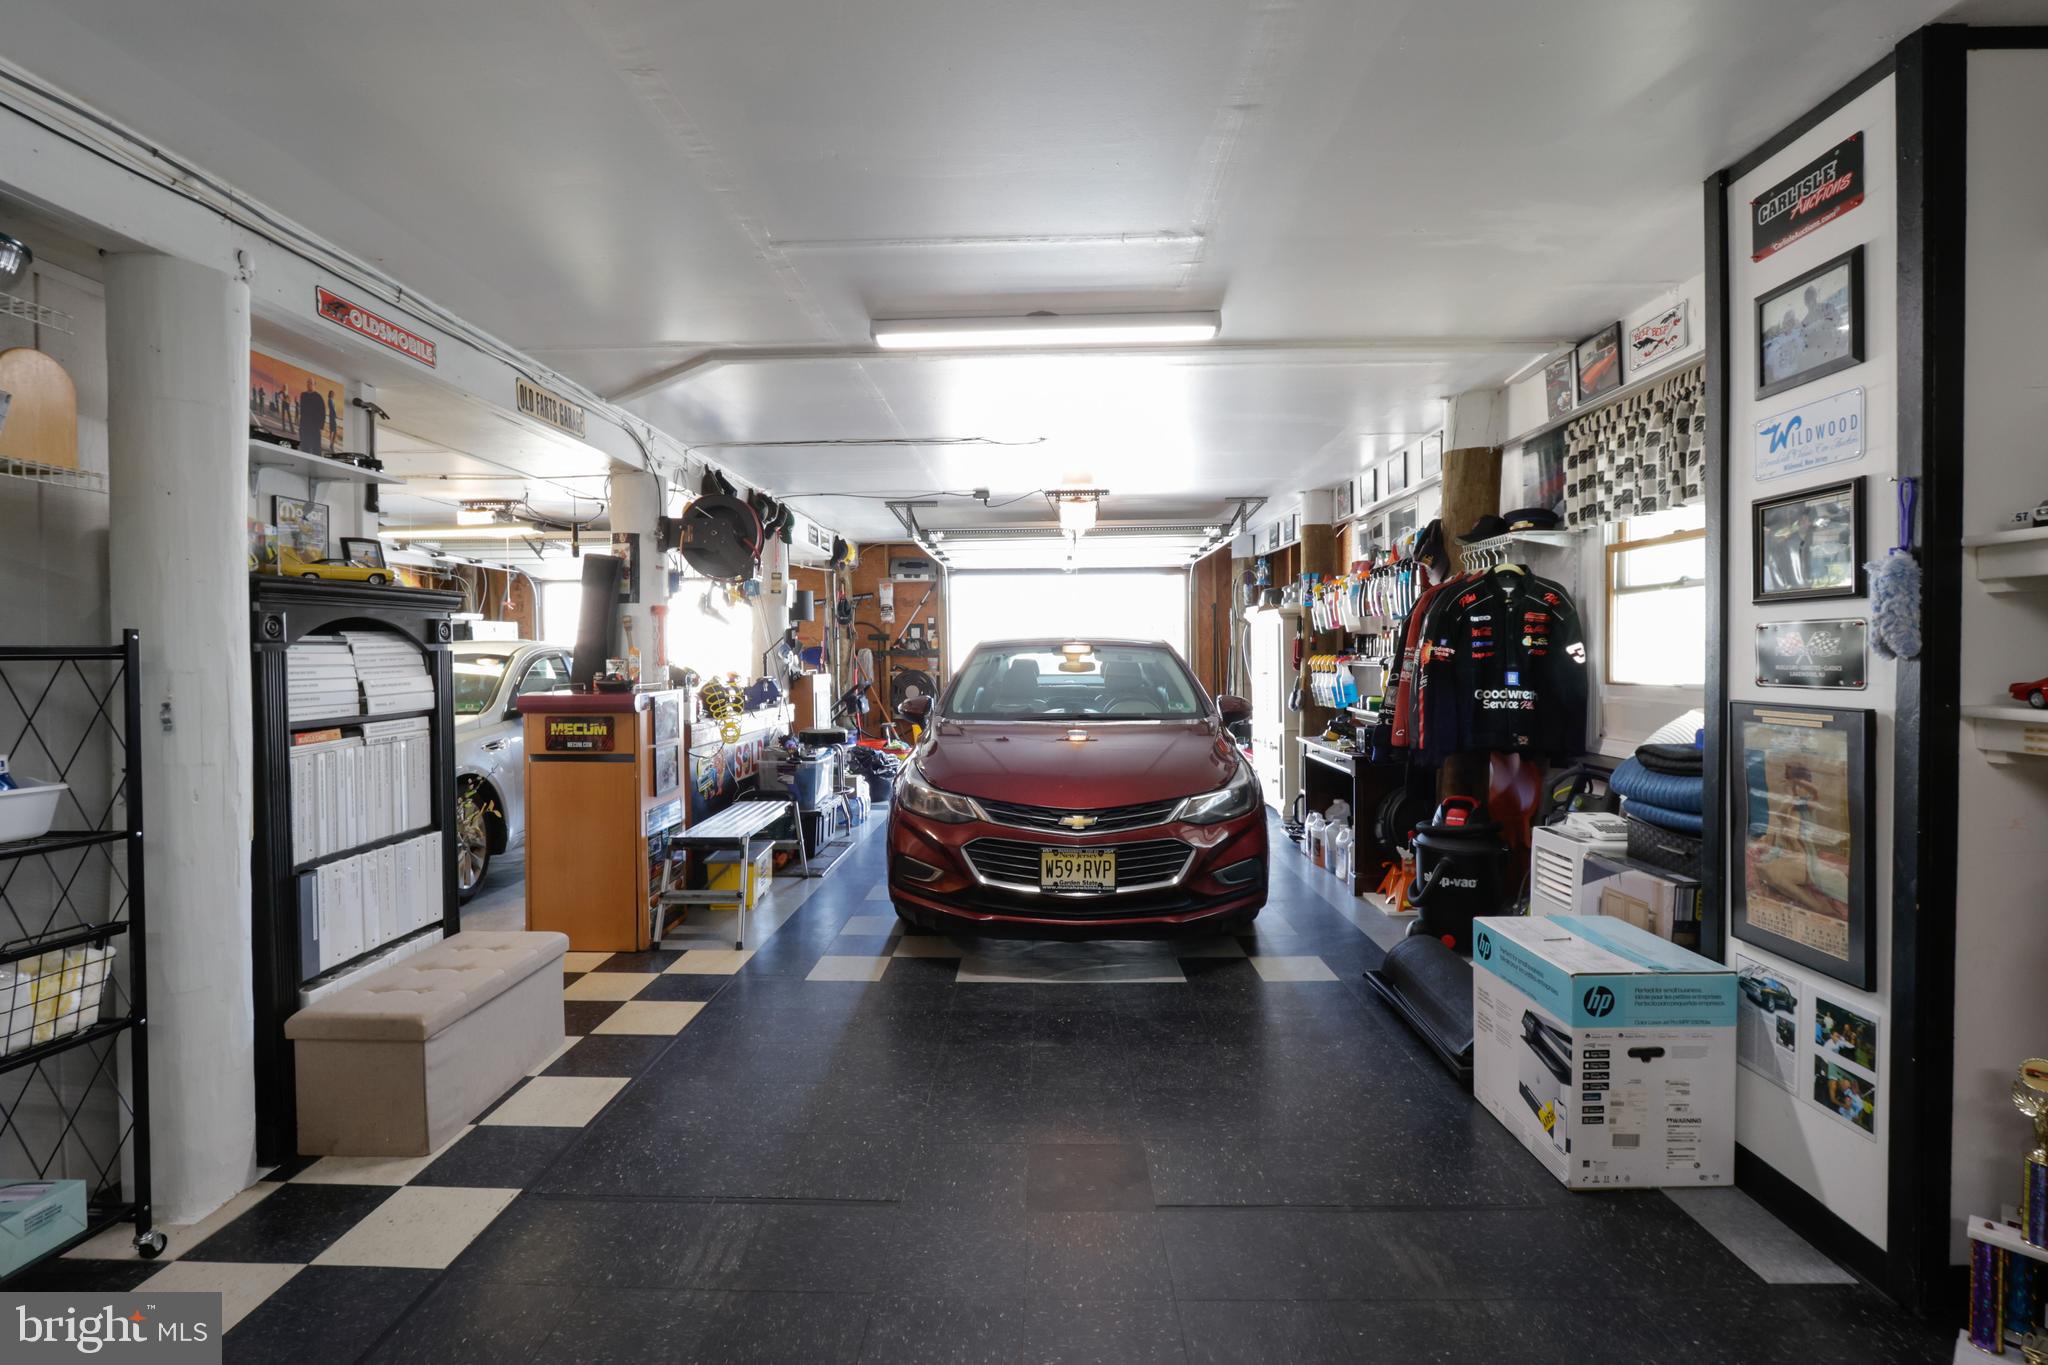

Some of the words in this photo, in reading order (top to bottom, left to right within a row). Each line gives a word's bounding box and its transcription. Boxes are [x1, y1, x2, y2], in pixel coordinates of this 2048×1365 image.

[1758, 160, 1838, 225] CARLISLE
[349, 309, 433, 362] OLDSMOBILE
[520, 384, 534, 412] OLD
[536, 391, 558, 423] FARTS
[559, 403, 584, 434] GARAGE
[1759, 414, 1858, 454] WILDWOOD
[1483, 699, 1519, 709] Service
[551, 723, 607, 735] MECUM
[1077, 851, 1098, 859] Jersey
[1083, 860, 1112, 879] RVP
[1479, 932, 1491, 960] hp
[1584, 986, 1615, 1017] hp
